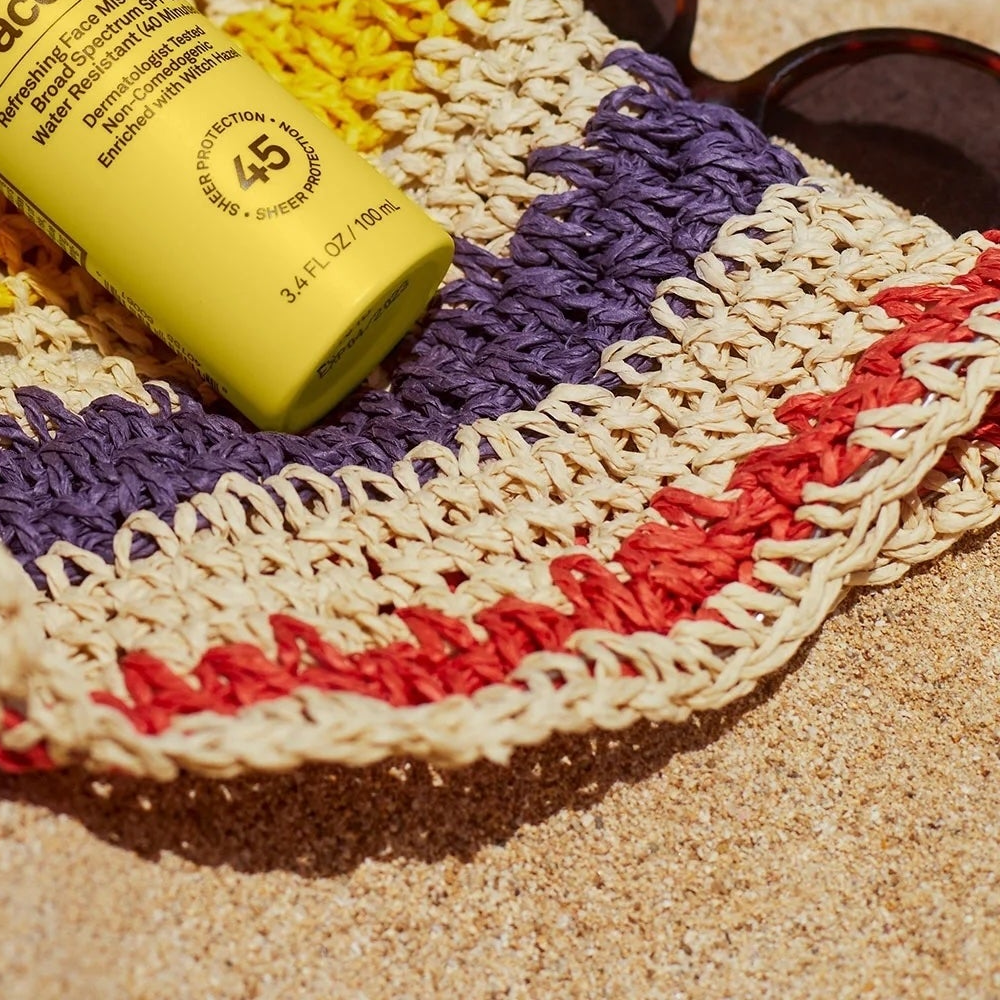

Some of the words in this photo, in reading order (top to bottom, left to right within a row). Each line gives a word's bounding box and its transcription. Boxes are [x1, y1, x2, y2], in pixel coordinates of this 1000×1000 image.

[30, 63, 75, 114] Broad
[70, 5, 144, 67] Spectrum
[59, 14, 100, 49] Face
[31, 98, 72, 145] Water
[67, 31, 142, 101] Resistant
[136, 16, 162, 38] (40
[82, 43, 174, 128] Dermatologist
[167, 25, 206, 48] Tested
[97, 105, 156, 168] Enriched
[152, 81, 185, 109] with
[179, 56, 217, 84] Witch
[212, 46, 242, 64] Hazel
[102, 41, 213, 134] Non-Comedogenic
[196, 111, 265, 171] PROTECTION
[233, 133, 291, 191] 45
[279, 121, 322, 194] PROTECTION
[198, 173, 241, 216] SHEER
[256, 191, 309, 220] SHEER
[280, 275, 309, 303] 3.4
[303, 257, 331, 278] FL
[324, 232, 352, 257] OZ
[346, 224, 357, 240] /
[354, 208, 383, 230] 100
[379, 198, 401, 216] mL
